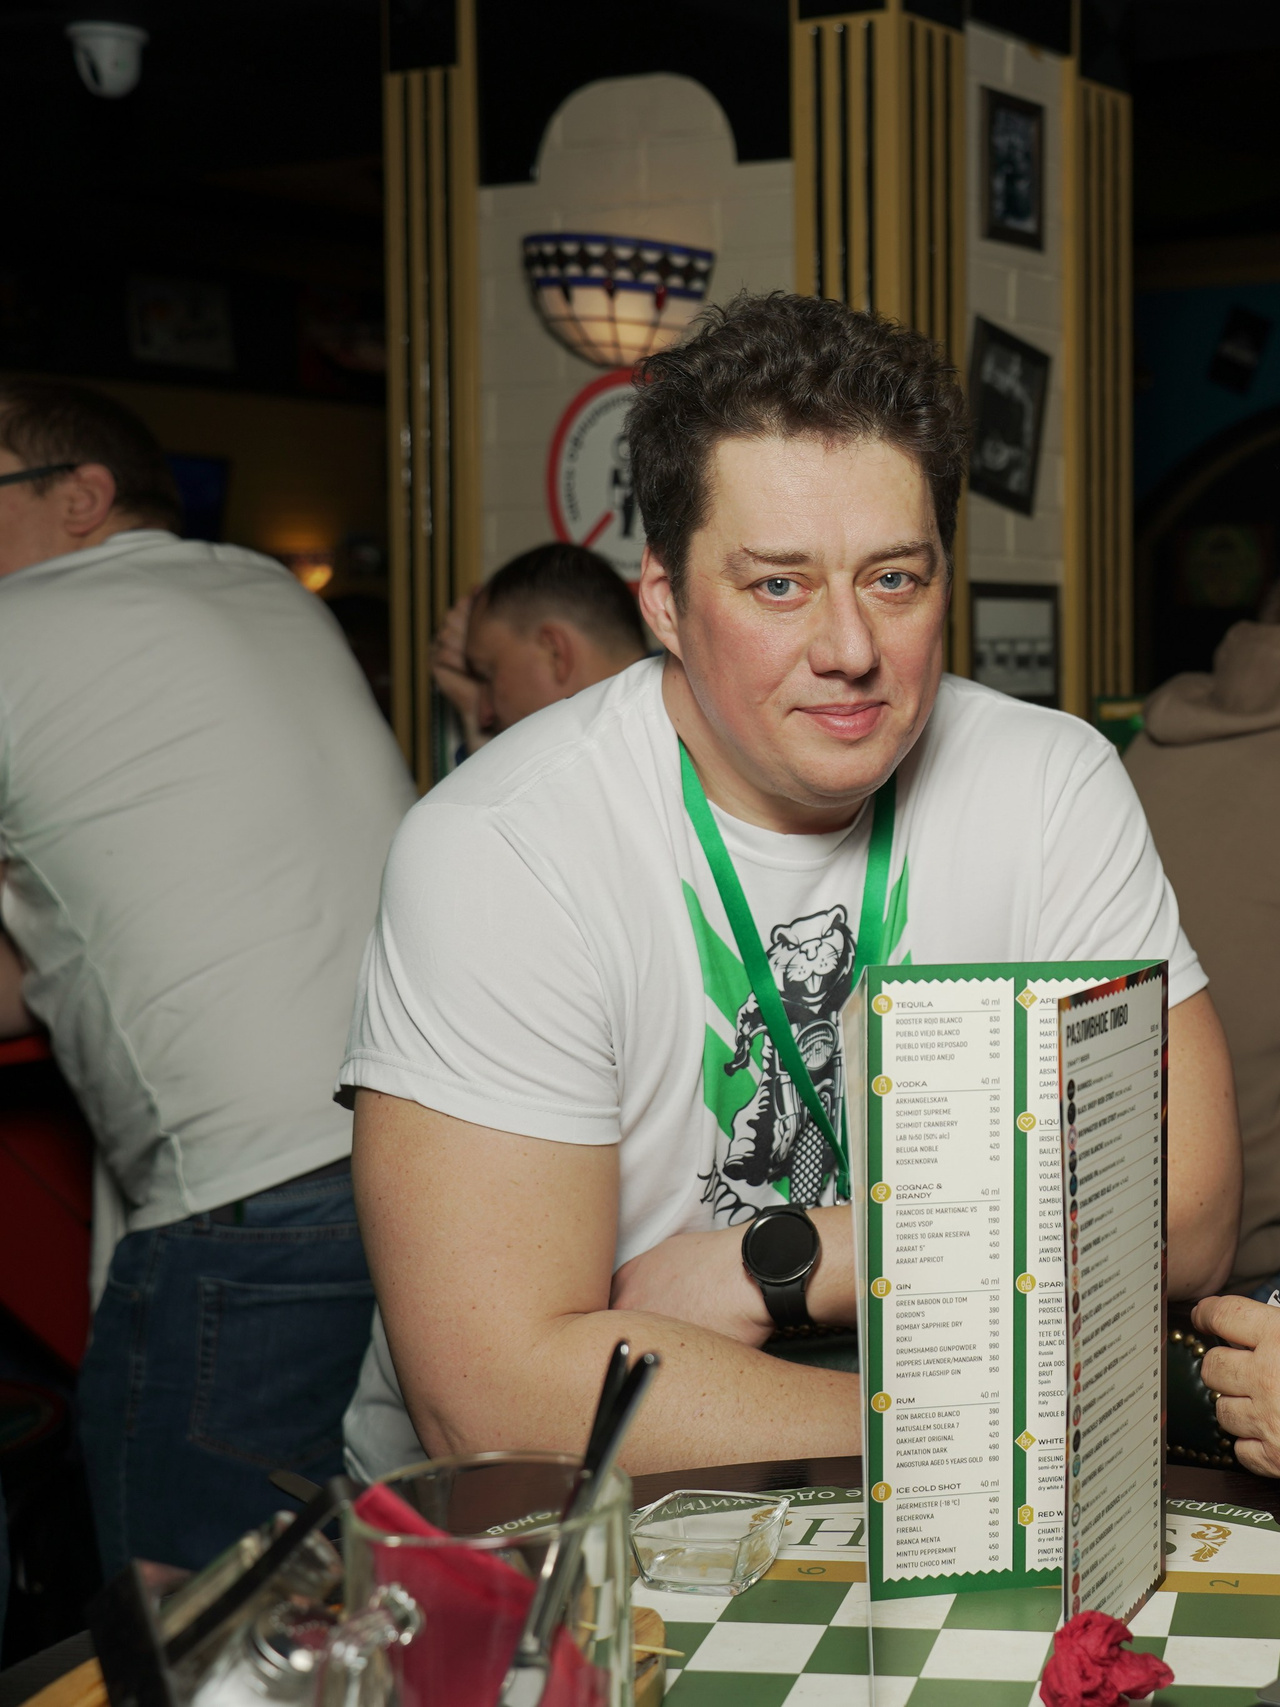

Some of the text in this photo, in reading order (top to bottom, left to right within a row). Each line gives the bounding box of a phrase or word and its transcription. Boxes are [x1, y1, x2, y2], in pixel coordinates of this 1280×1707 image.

[896, 1000, 933, 1009] TEQUILA
[981, 998, 989, 1006] 40
[939, 1016, 962, 1024] BLANCO
[1066, 1003, 1129, 1048] РАЗЛИВНОЕ ПИВО
[895, 1042, 918, 1050] PUEBLO
[895, 1080, 927, 1088] VODKA
[981, 1077, 989, 1085] 40
[895, 1096, 947, 1104] ARKHANGELSKAYA
[923, 1108, 950, 1116] SUPREME
[895, 1120, 957, 1129] SCHMIDT CRANBERRY
[895, 1157, 938, 1165] KOSKENKORVA
[895, 1183, 934, 1192] COGNAC
[980, 1188, 989, 1196] 40
[895, 1191, 931, 1200] BRANDY
[935, 1206, 968, 1214] MARTIGNAC
[896, 1232, 918, 1240] TORRES
[927, 1231, 943, 1239] GRAN
[944, 1230, 970, 1238] RESERVA
[1038, 1246, 1060, 1254] JAWBOX
[919, 1255, 943, 1263] APRICOT
[916, 1297, 940, 1305] BABOON
[895, 1310, 925, 1319] GORDON'S
[895, 1323, 920, 1331] BOMBAY
[921, 1321, 949, 1329] SAPPHIRE
[895, 1335, 912, 1343] ROKU
[939, 1343, 976, 1352] GUNPOWDER
[895, 1358, 922, 1367] HOPPERS
[922, 1369, 949, 1377] FLAGSHIP
[980, 1390, 999, 1399] 40 ml
[895, 1396, 915, 1404] RUM
[909, 1411, 936, 1420] BARCELO
[937, 1410, 960, 1418] BLANCO
[896, 1423, 931, 1433] MATUSALEM
[932, 1422, 955, 1430] SOLERA
[895, 1434, 953, 1444] OAKHEART ORIGINAL
[988, 1442, 999, 1450] 490
[896, 1446, 947, 1456] PLANTATION DARK
[988, 1454, 999, 1462] 690
[1038, 1455, 1063, 1463] RIESLING
[896, 1460, 929, 1468] ANGOSTURA
[930, 1458, 944, 1466] AGED
[896, 1482, 961, 1494] ICE COLD SHOT
[980, 1479, 989, 1488] 40
[989, 1507, 1000, 1515] 470
[896, 1512, 934, 1522] BECHEROVKA
[896, 1525, 922, 1534] FIREBALL
[988, 1530, 1000, 1538] 550
[896, 1535, 940, 1546] BRANCA MENTA
[896, 1546, 956, 1558] MINTTU PEPPERMINT
[988, 1554, 999, 1562] 450
[896, 1561, 918, 1570] MINTTU
[919, 1559, 940, 1568] CHOCO
